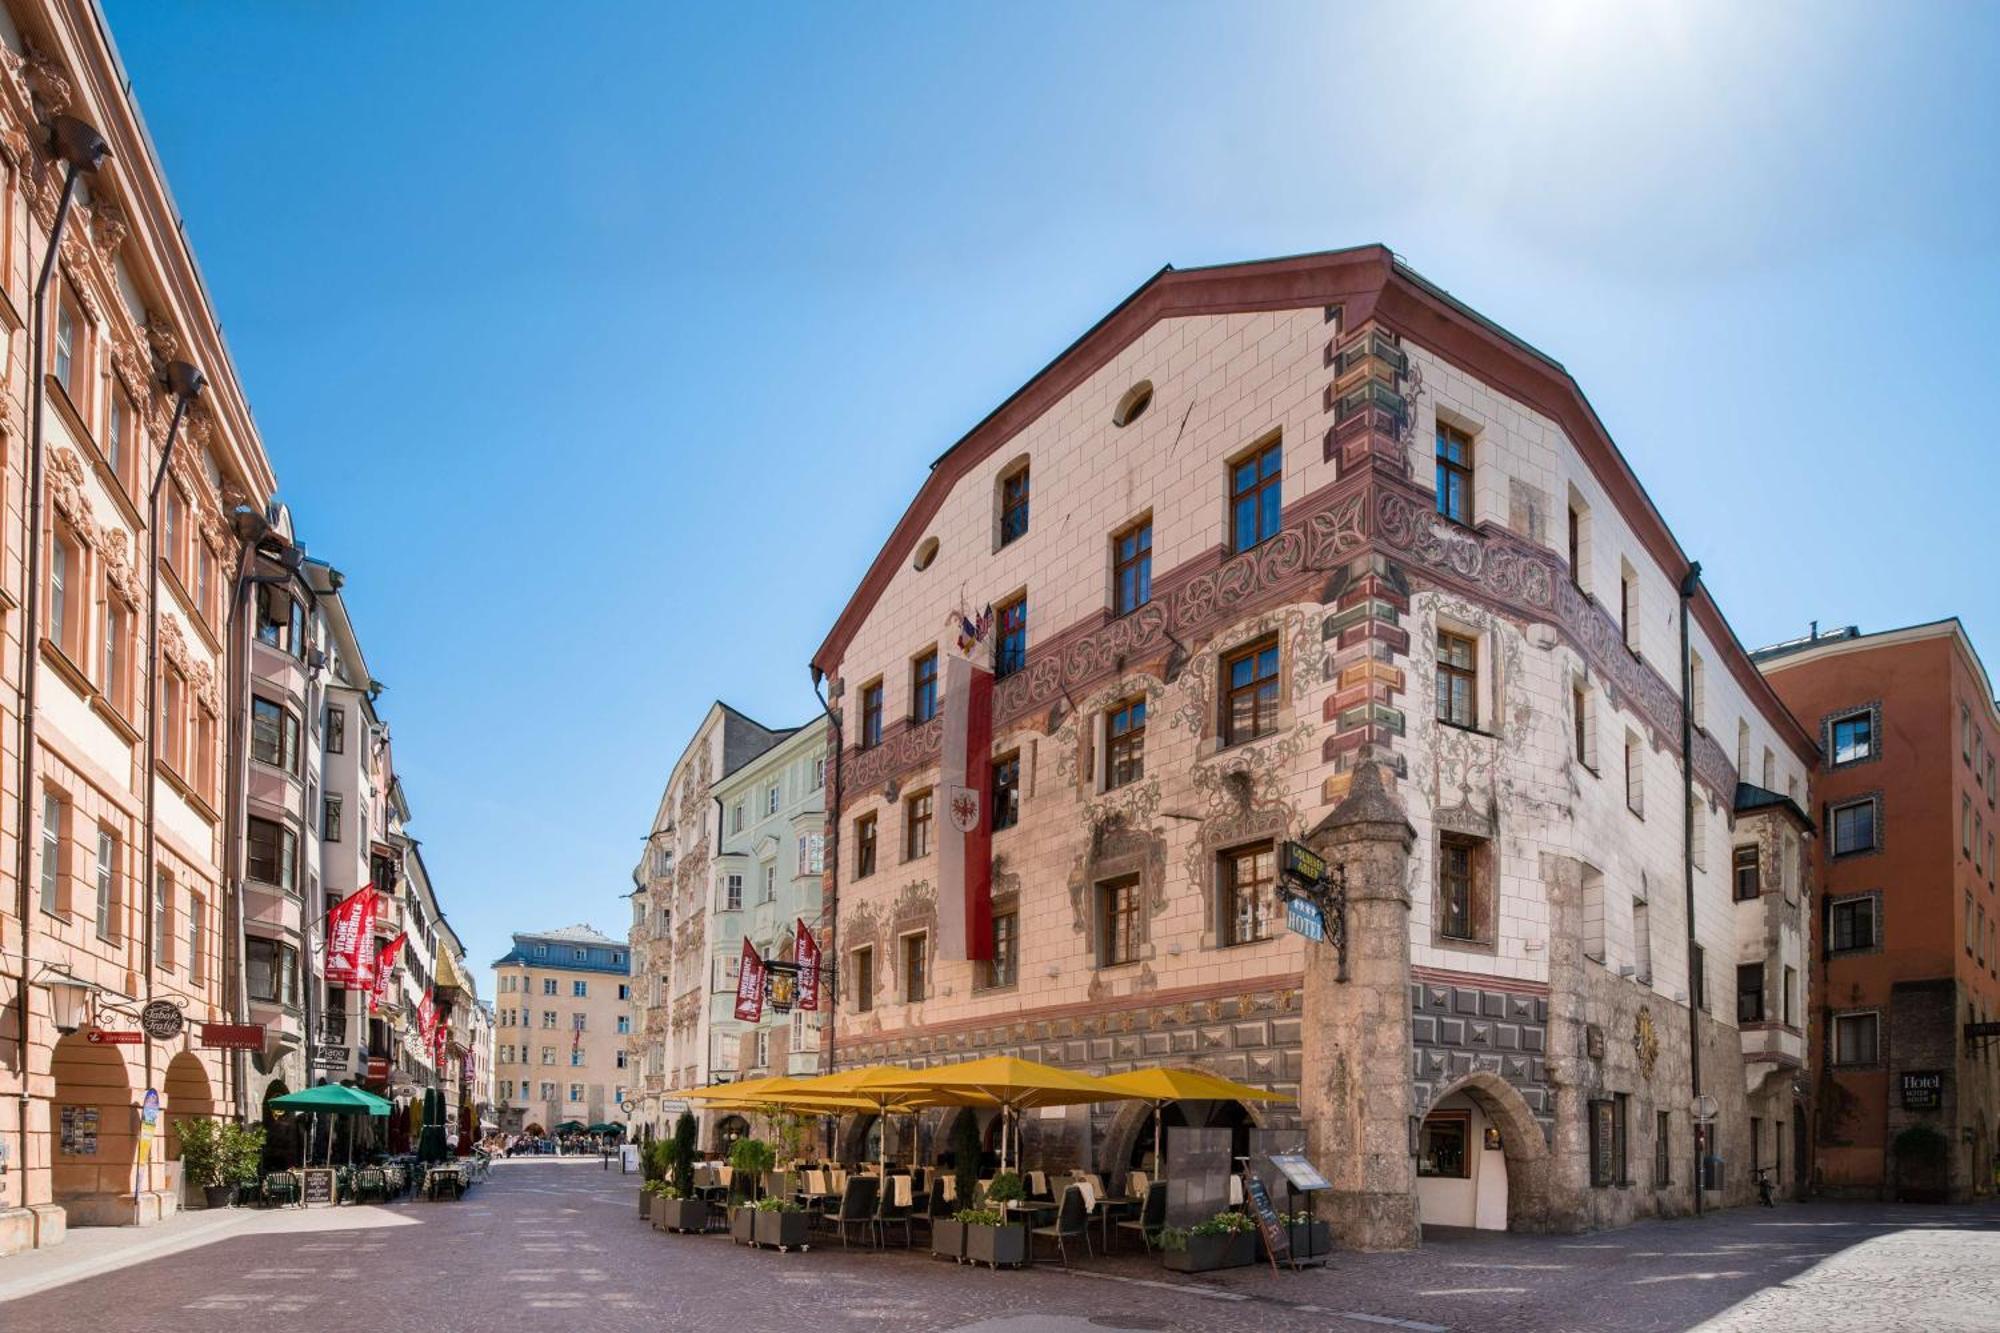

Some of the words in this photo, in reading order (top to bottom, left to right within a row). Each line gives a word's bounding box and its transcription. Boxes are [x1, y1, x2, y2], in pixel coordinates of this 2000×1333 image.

[1288, 911, 1324, 942] HOTEL
[740, 957, 751, 999] INNSBRUCK
[747, 973, 757, 1000] ALPINE
[145, 1007, 179, 1021] Tabak
[146, 1019, 179, 1035] Trafik
[317, 1047, 345, 1059] Piano
[1904, 1075, 1939, 1088] Hotel
